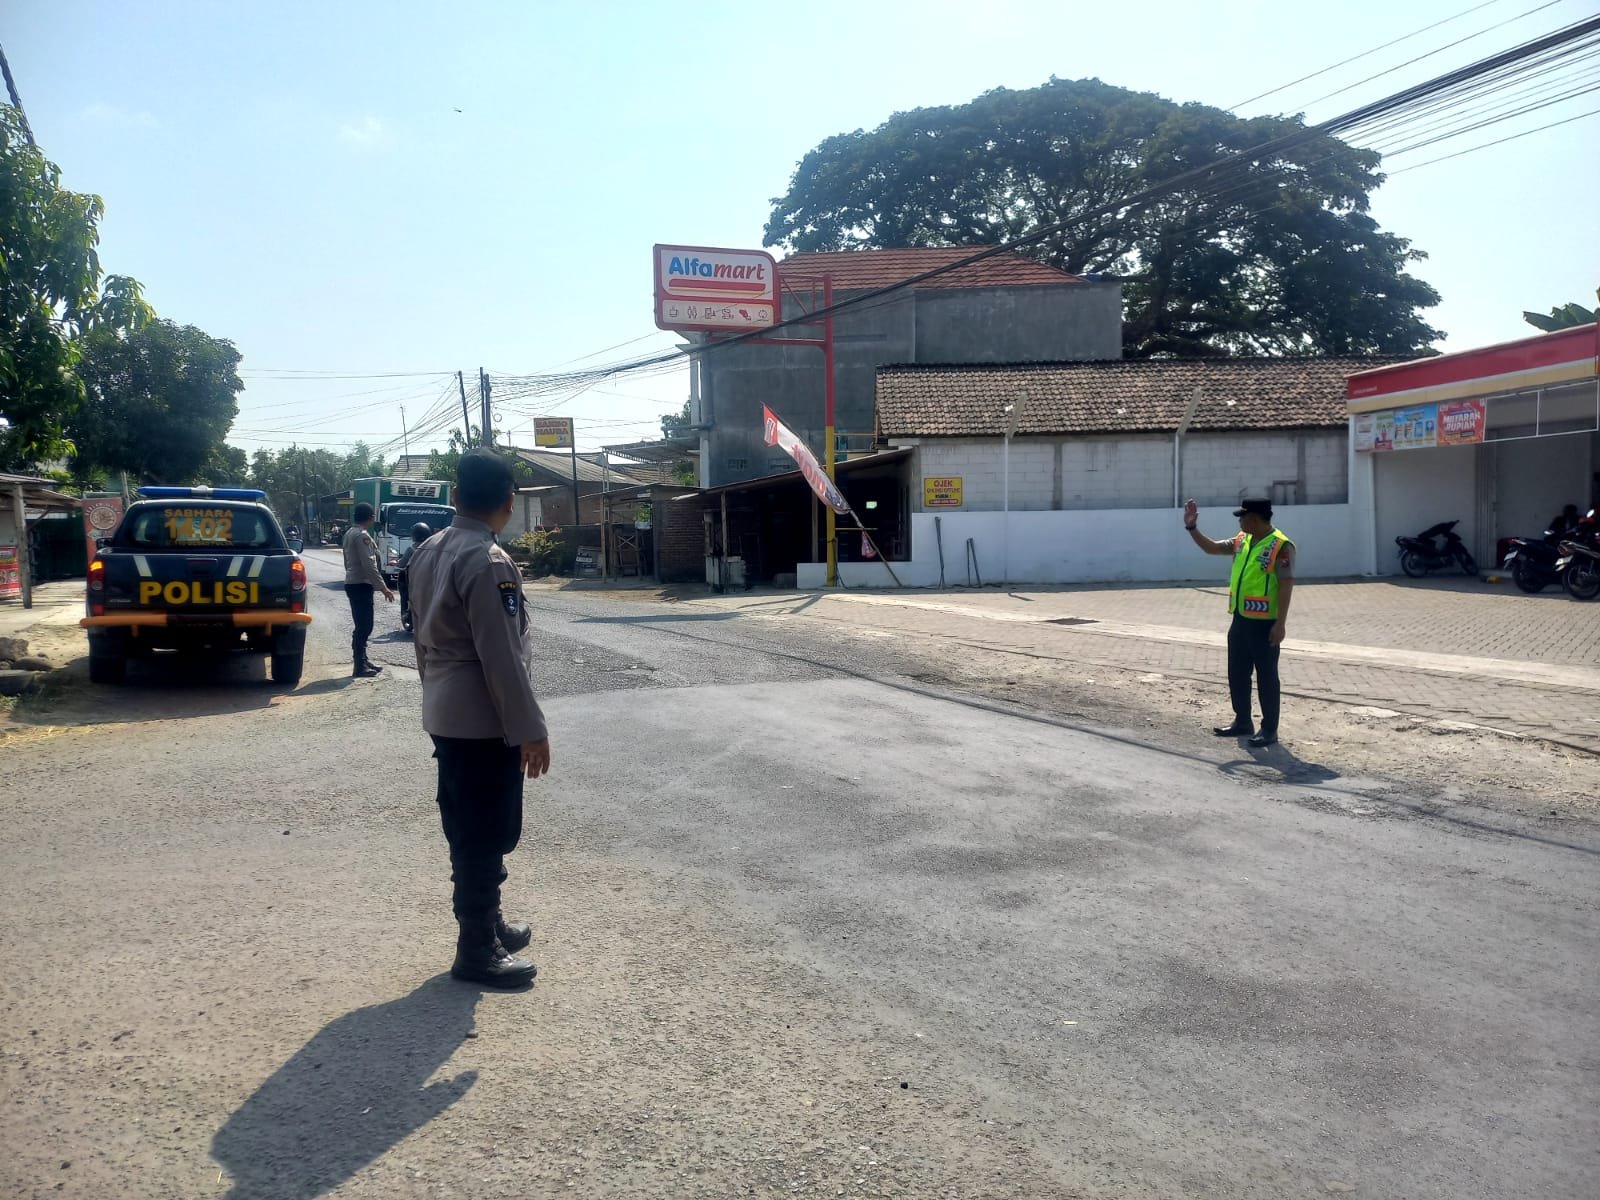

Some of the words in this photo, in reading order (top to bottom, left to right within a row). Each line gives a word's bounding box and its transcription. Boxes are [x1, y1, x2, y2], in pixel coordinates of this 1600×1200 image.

[668, 256, 765, 280] Alfamart
[164, 509, 233, 518] SABHARA
[139, 581, 259, 605] POLISI
